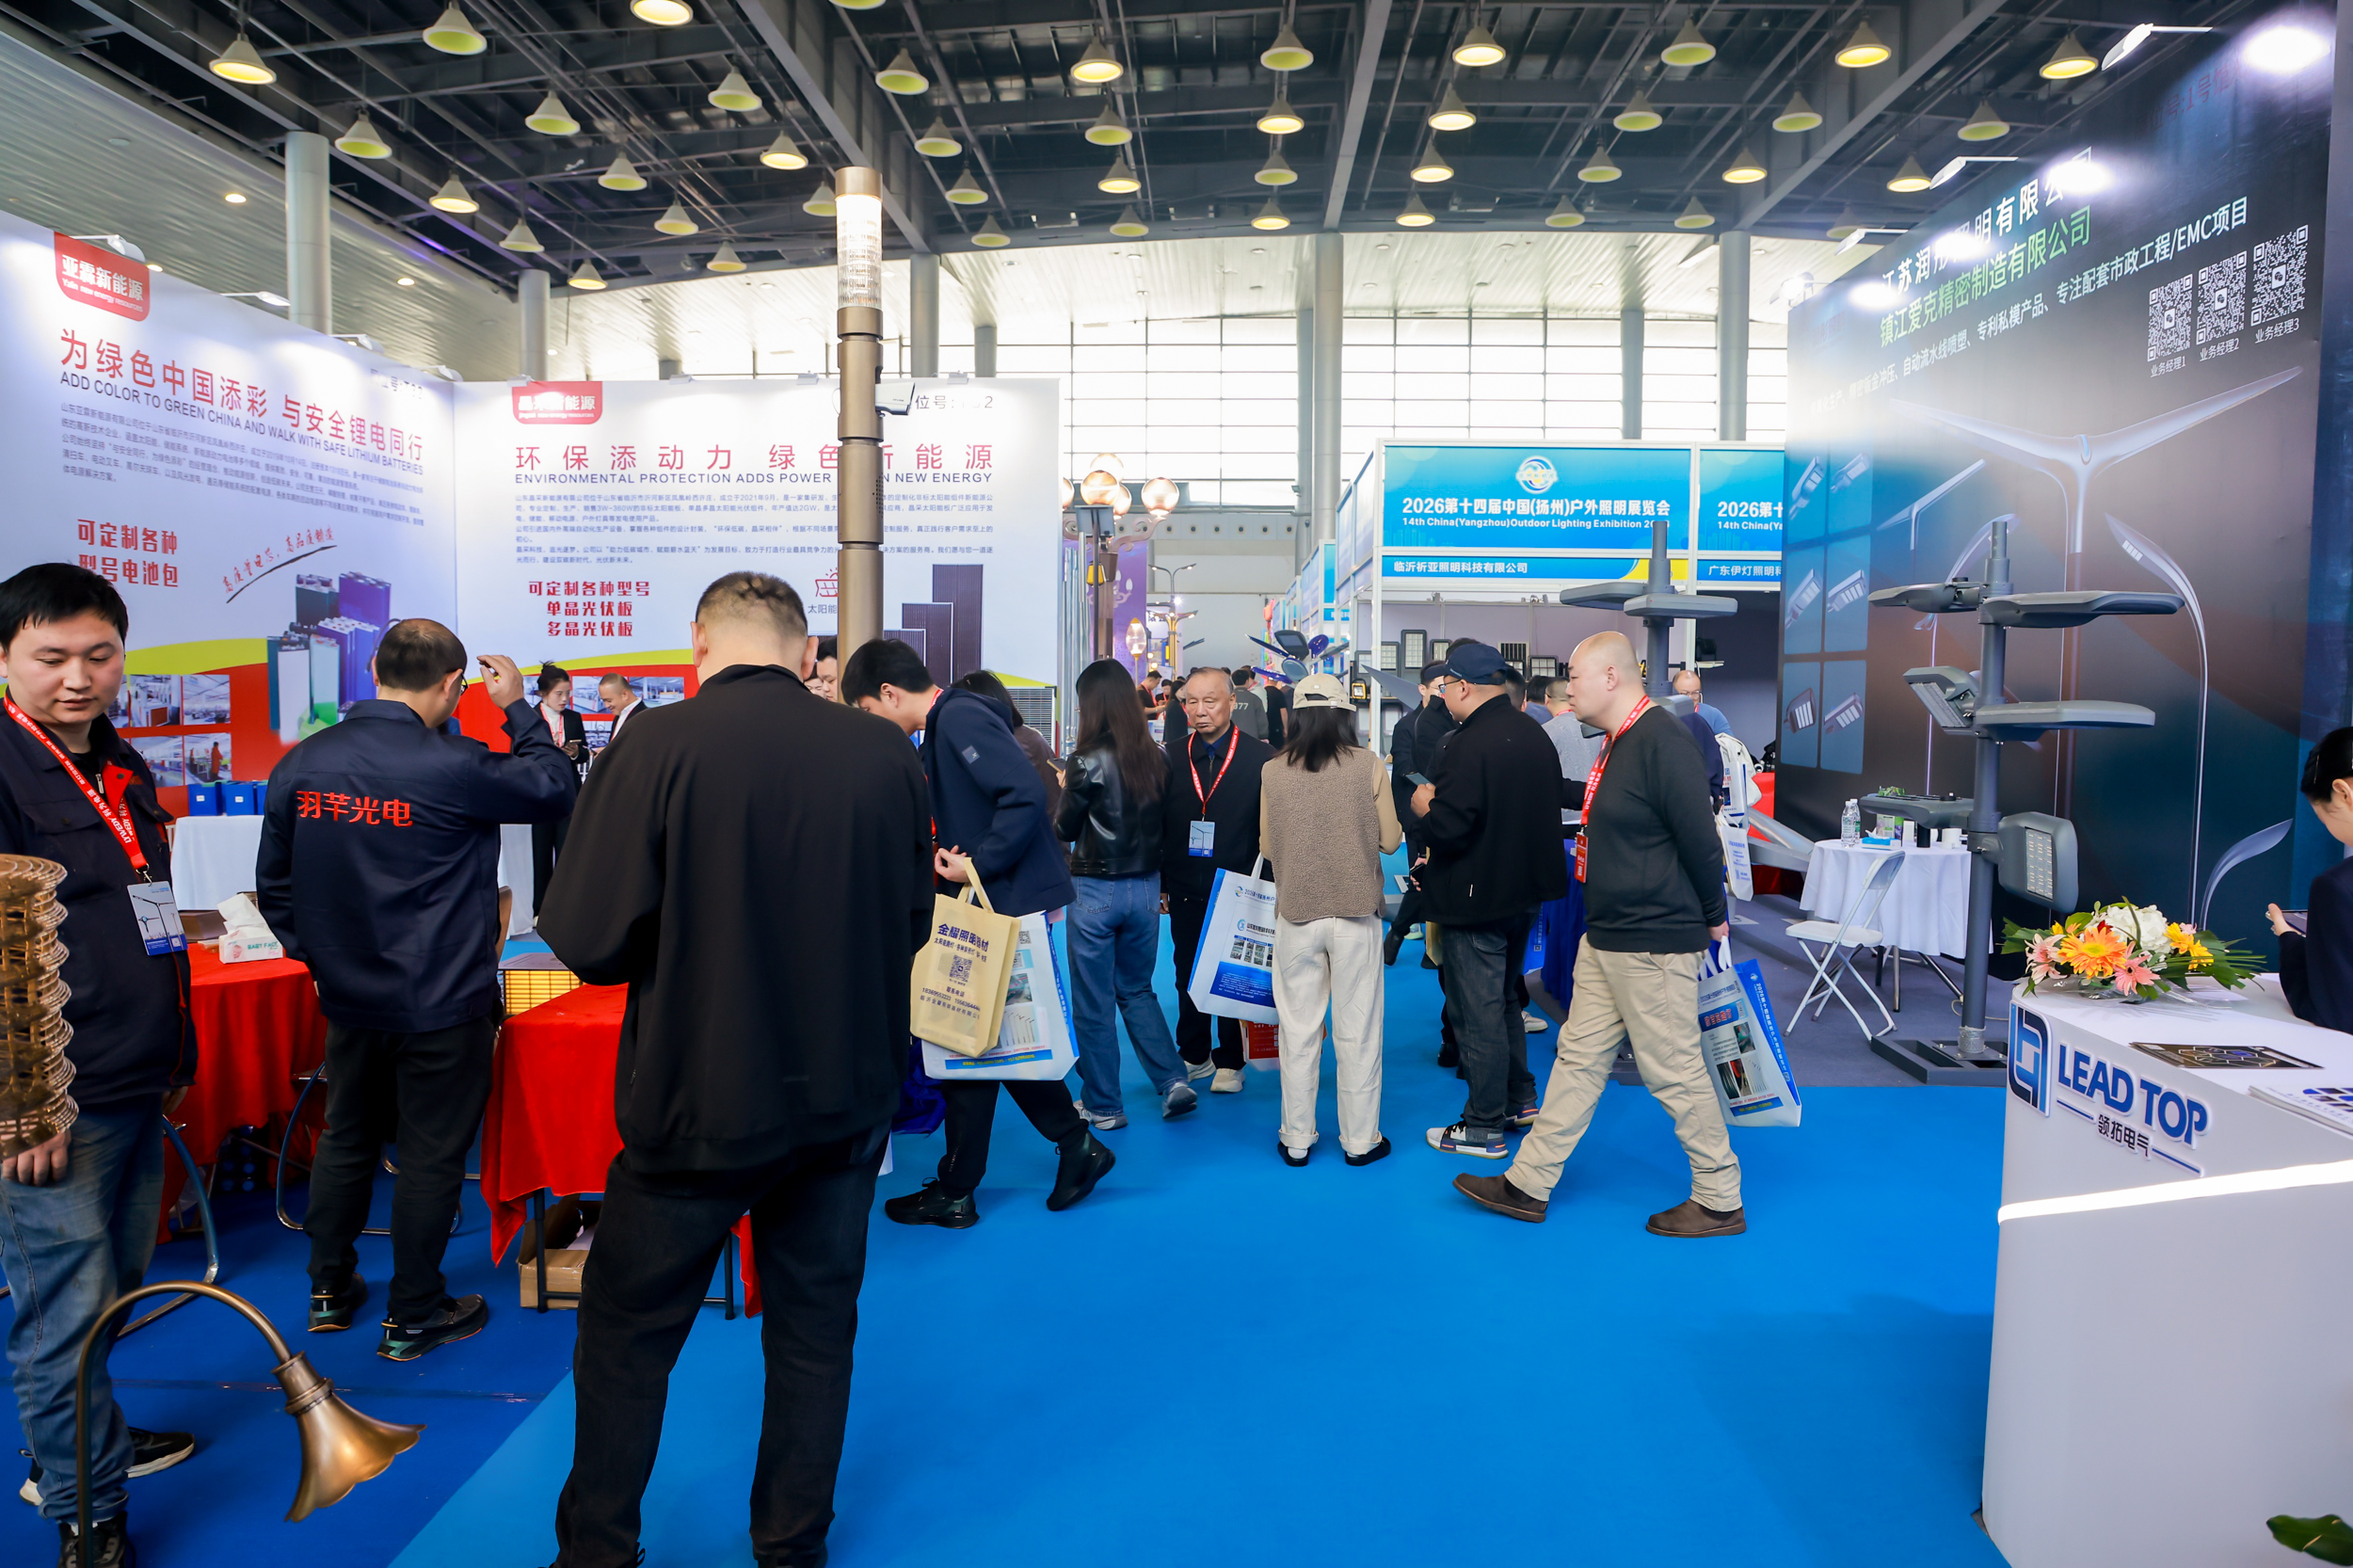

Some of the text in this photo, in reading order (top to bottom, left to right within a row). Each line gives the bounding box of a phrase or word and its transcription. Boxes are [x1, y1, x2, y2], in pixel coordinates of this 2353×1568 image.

[62, 254, 143, 301] 亚霖新能源
[1880, 204, 2091, 348] 镇江爱克精密制造有限公司
[2254, 318, 2299, 344] 业务经理3
[2200, 338, 2240, 361] 业务经理2
[2151, 356, 2185, 377] 业务经理1
[60, 328, 267, 418] 为绿色中国添彩
[282, 394, 423, 461] 与安全锂电同行
[60, 371, 424, 475] ADD COLOR TO GREEN CHINA AND WALK WITH SAFE LITHIUM BATTERIES
[516, 444, 732, 471] 环保添动力
[515, 472, 636, 484] ENVIRONMENTAL
[640, 472, 731, 484] PROTECTION
[736, 472, 775, 484] ADDS
[780, 472, 831, 484] POWER
[896, 472, 928, 483] NEW
[933, 472, 993, 483] ENERGY
[1401, 497, 1671, 516] 2026第十四届中国(扬州)户外照明展览会
[1402, 518, 1426, 527] 14th
[1427, 518, 1550, 529] China(Yangzhou)Outdoor
[1551, 519, 1592, 529] Lighting
[1593, 519, 1642, 529] Exhibition
[1718, 520, 1740, 530] 14th
[77, 519, 178, 554] 可定制各种
[528, 581, 650, 597] 可定制各种型号
[547, 600, 632, 616] 单晶光伏板
[548, 621, 632, 637] 多晶光伏板
[2058, 1044, 2208, 1145] LEAD TOP
[2098, 1113, 2149, 1158] 领拓电气
